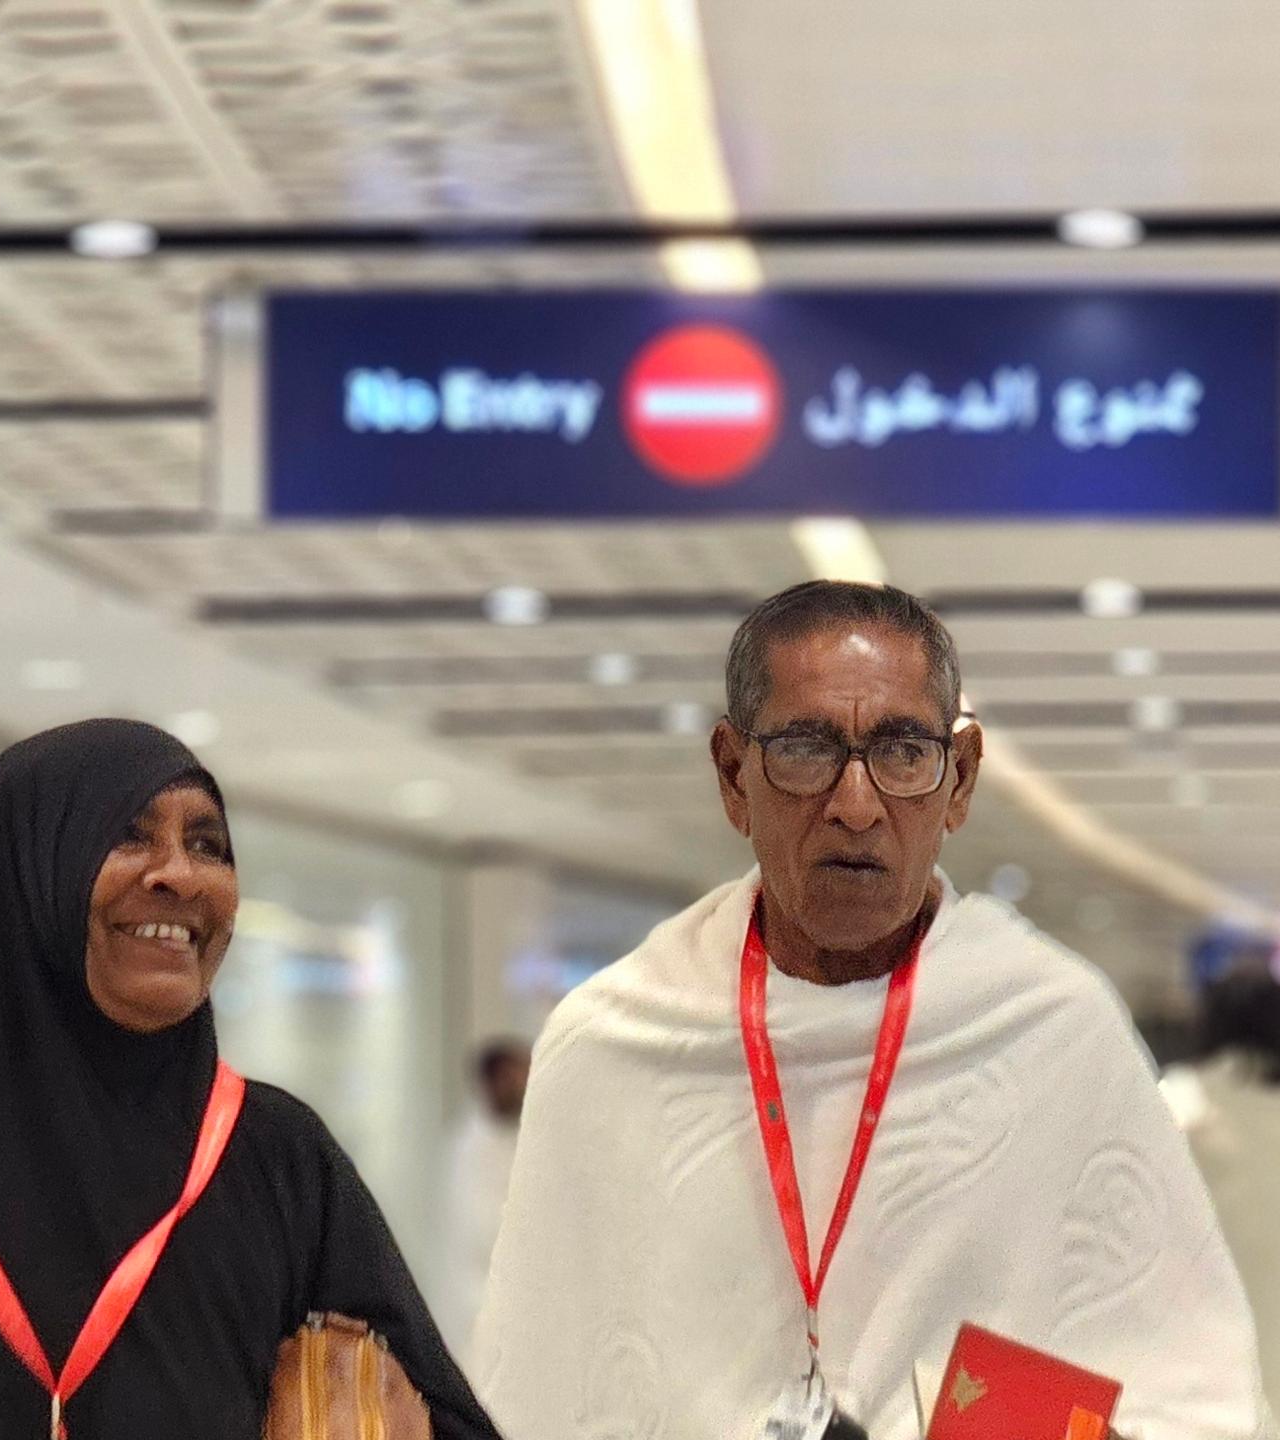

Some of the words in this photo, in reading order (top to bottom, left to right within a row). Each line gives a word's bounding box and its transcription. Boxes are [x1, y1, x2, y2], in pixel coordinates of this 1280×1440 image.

[345, 369, 438, 432] No
[441, 369, 603, 441] Entry
[804, 365, 1038, 447] الدخول
[1054, 370, 1202, 449] ممنوع
